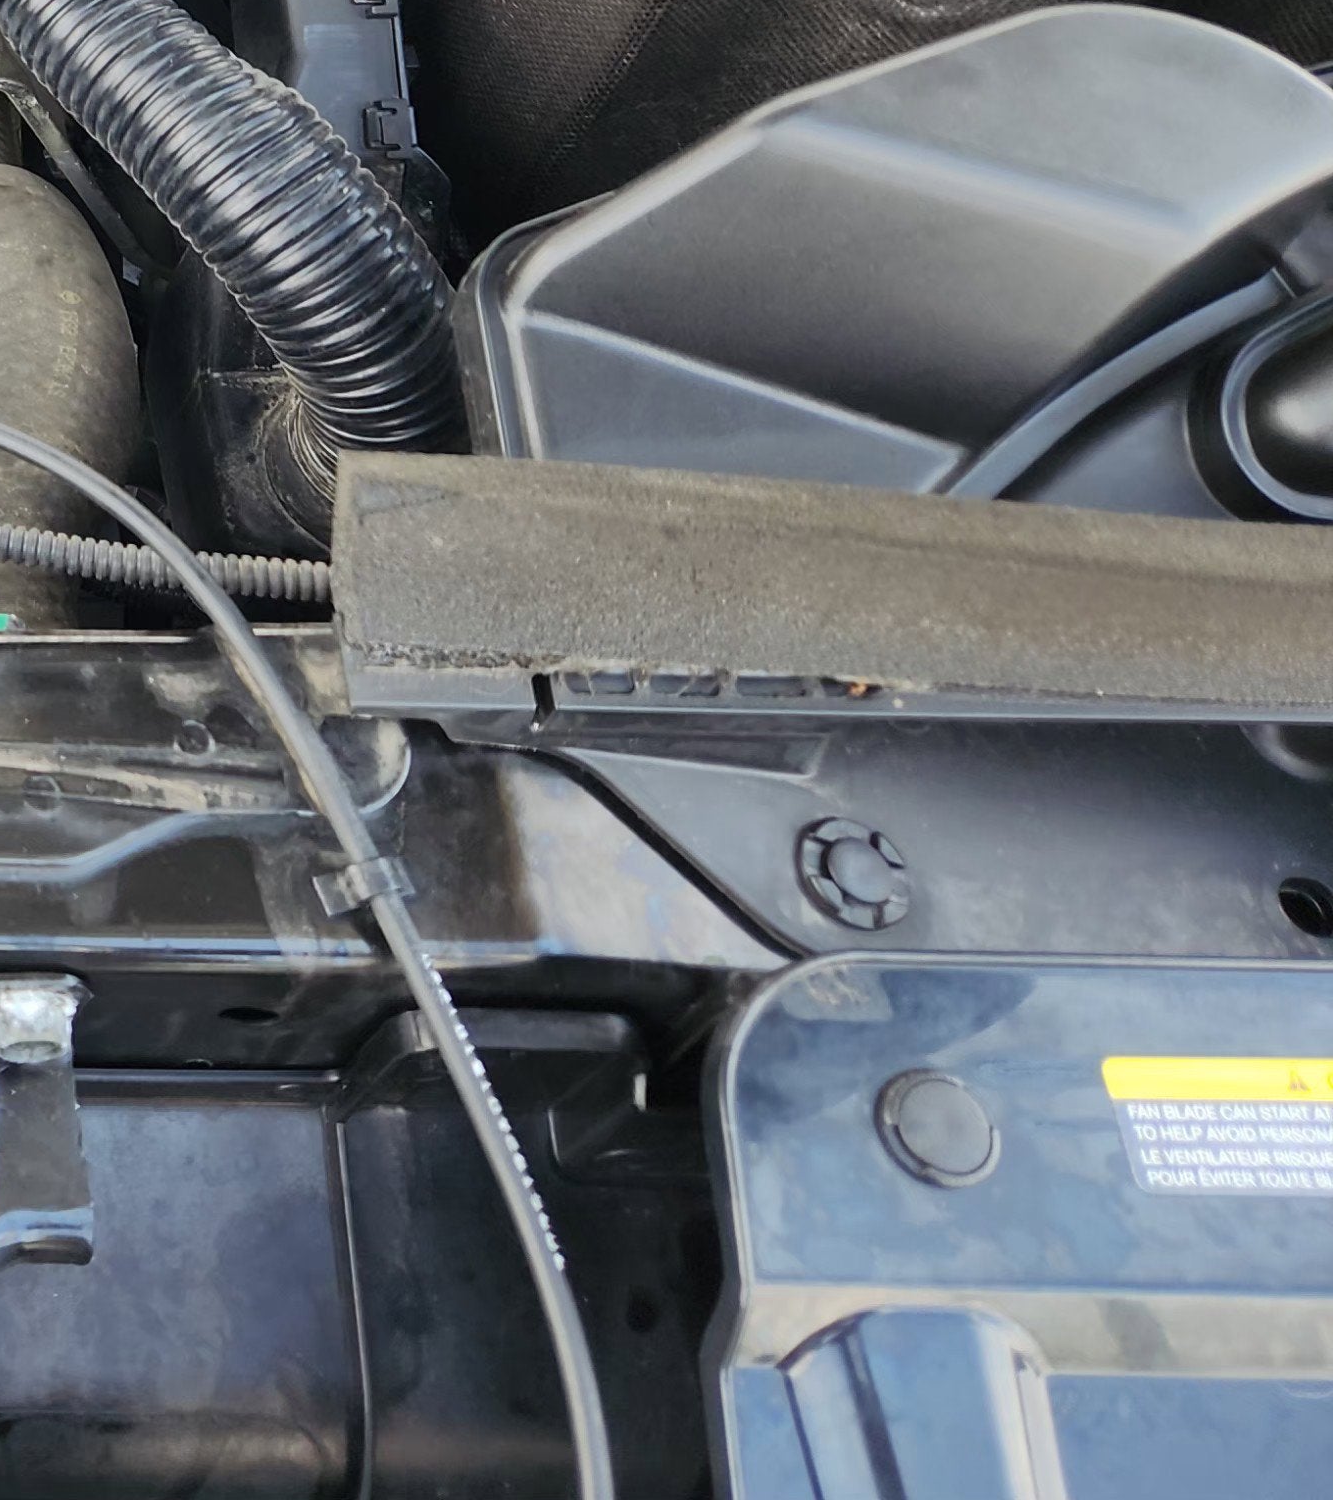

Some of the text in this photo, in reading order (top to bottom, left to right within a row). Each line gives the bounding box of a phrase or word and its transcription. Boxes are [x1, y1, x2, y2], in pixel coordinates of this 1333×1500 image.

[1127, 1103, 1161, 1120] FAN
[1162, 1104, 1218, 1121] BLADE
[1219, 1104, 1259, 1121] CAN
[1259, 1105, 1308, 1122] START
[1132, 1124, 1158, 1141] TO
[1159, 1124, 1204, 1141] HELP
[1206, 1124, 1257, 1142] AVOID
[1140, 1148, 1164, 1166] LE
[1163, 1148, 1272, 1167] VENTILATEUR
[1146, 1169, 1198, 1187] POUR
[1197, 1165, 1258, 1188] ÉVITER
[1259, 1170, 1314, 1189] TOUTE
